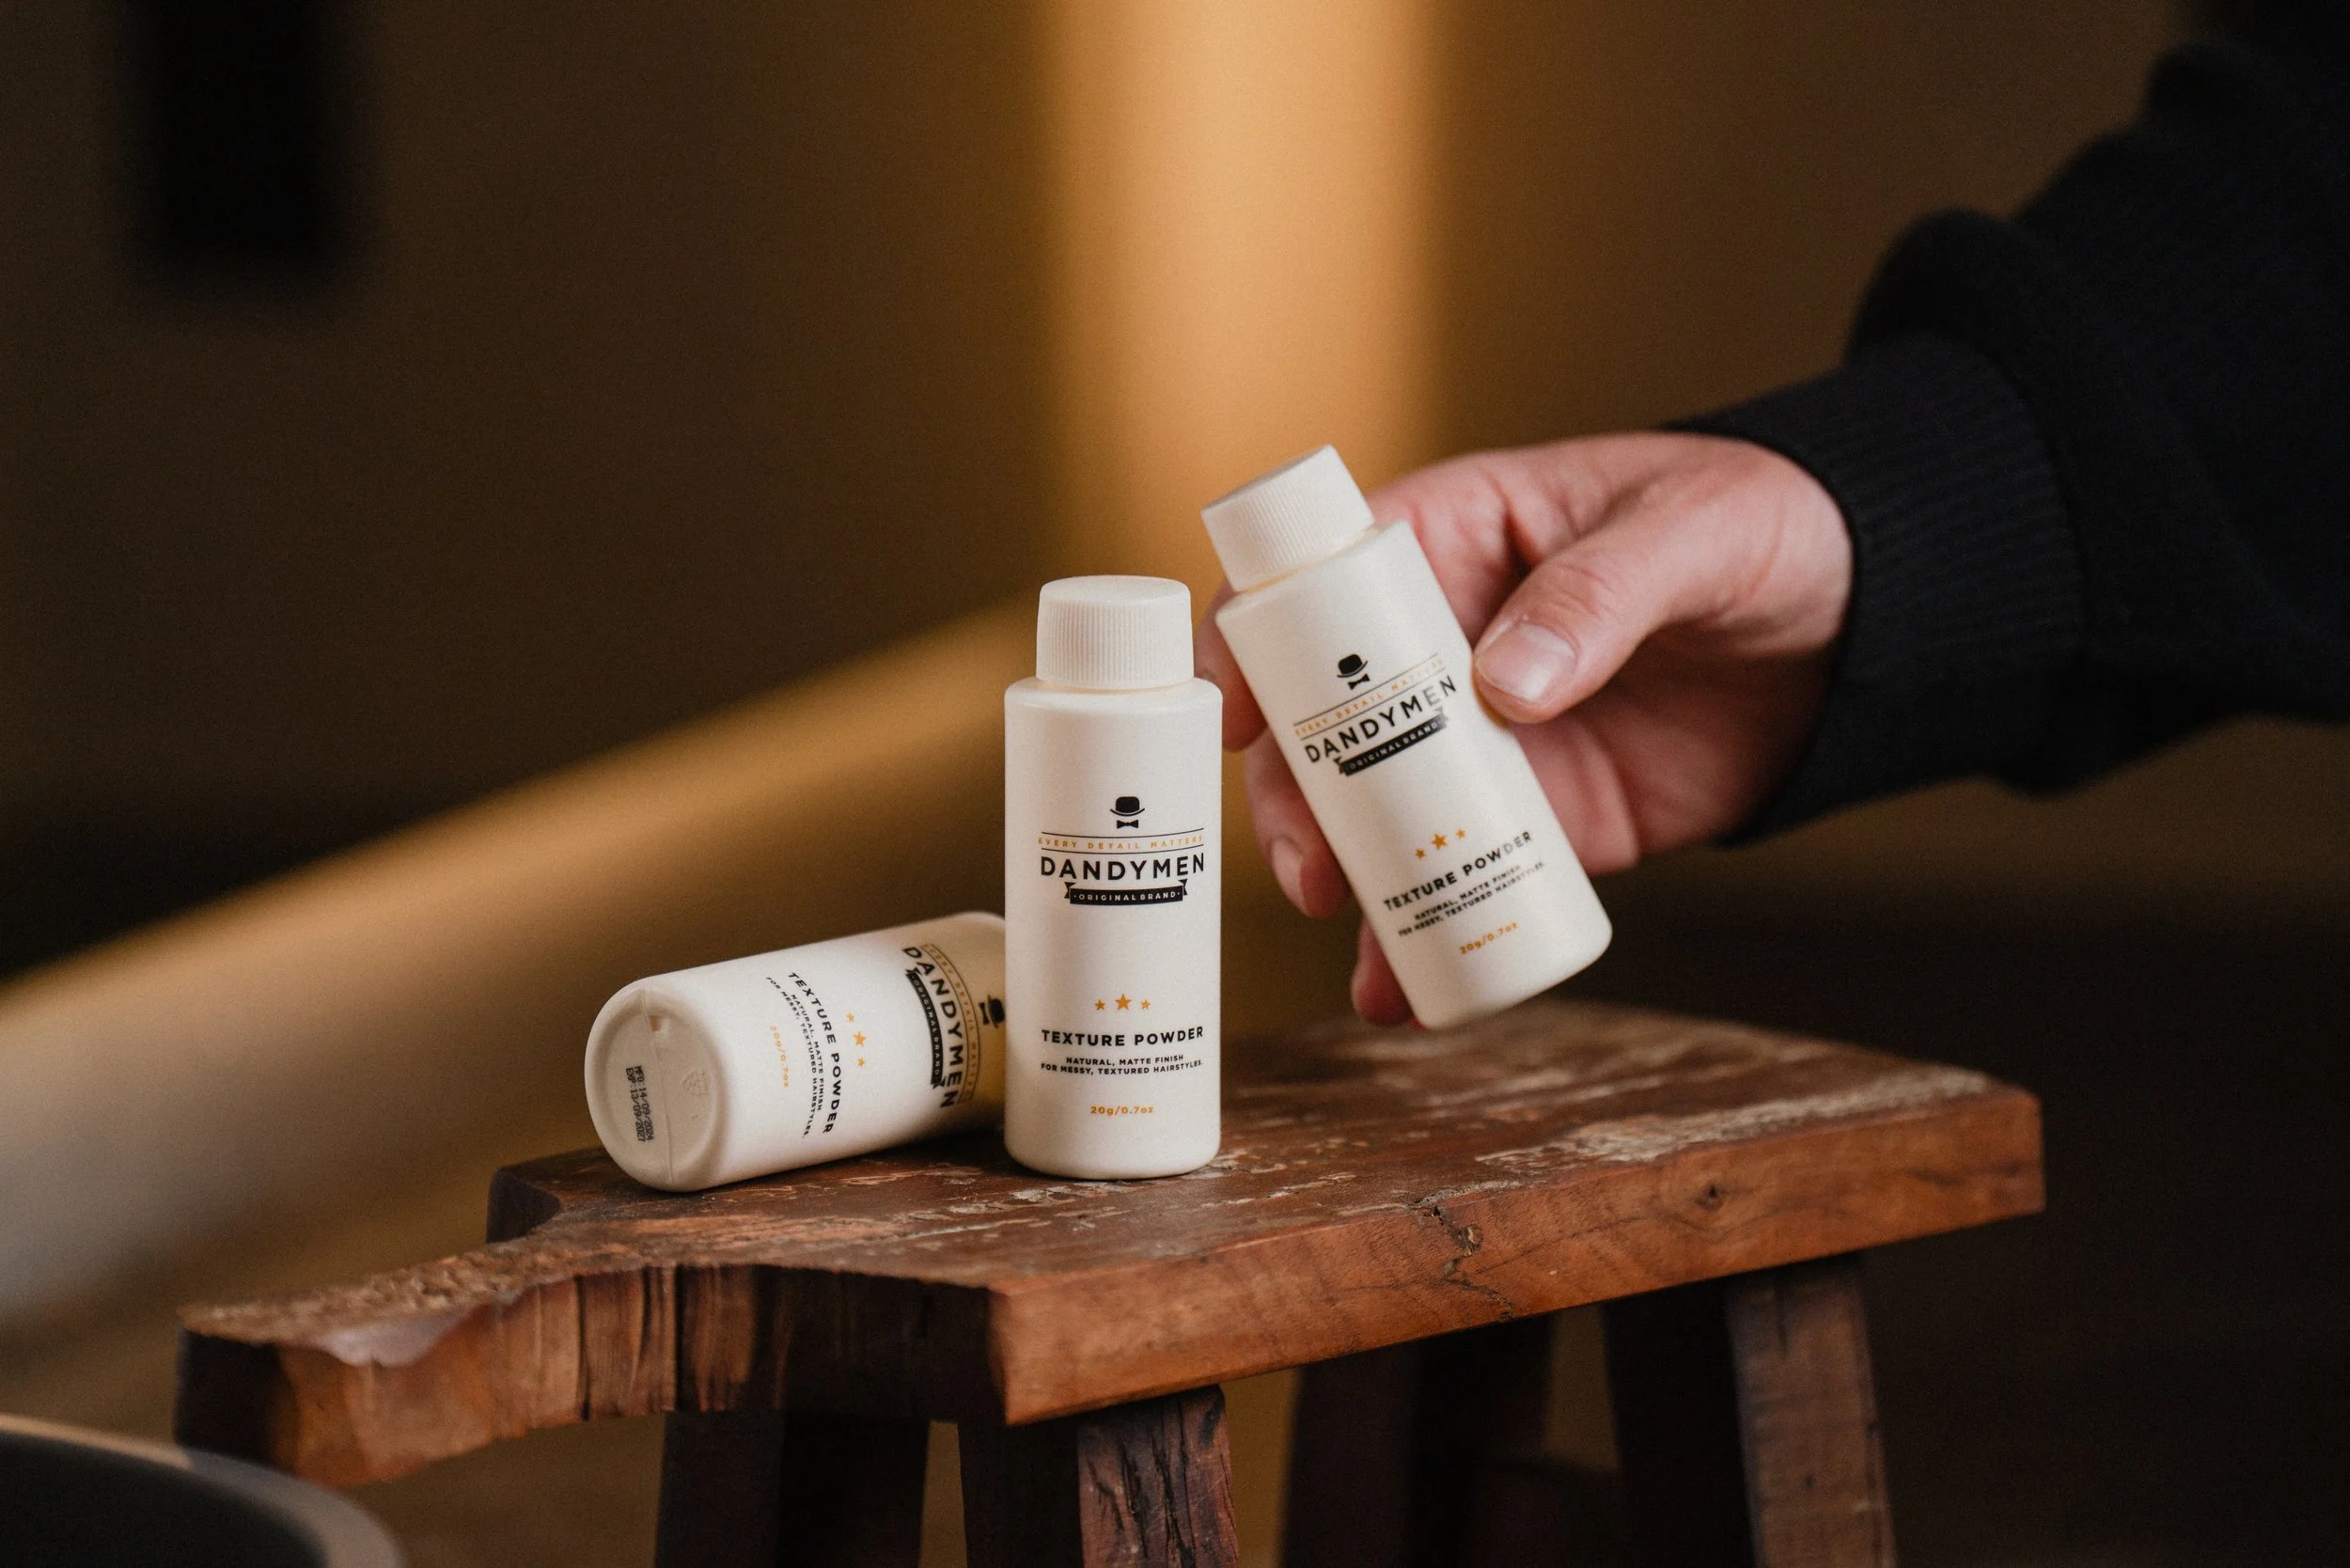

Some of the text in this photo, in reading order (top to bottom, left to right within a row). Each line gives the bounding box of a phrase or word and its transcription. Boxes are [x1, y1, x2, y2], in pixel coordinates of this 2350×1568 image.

[1305, 675, 1456, 762] DANDYMEN
[1349, 721, 1439, 771] ORIGINAL BRAND
[1038, 837, 1078, 849] EVERY
[1151, 835, 1203, 849] MATTERS
[1041, 853, 1204, 881] DANDYMEN
[1384, 831, 1532, 912] TEXTURE POWDER
[1078, 891, 1176, 902] ORIGINAL BRAND
[1445, 891, 1494, 917] TEXTURED
[1460, 881, 1490, 902] MATTE
[914, 980, 937, 1032] ORIGINAL
[902, 947, 964, 1107] DANDYMEN
[1042, 1027, 1203, 1046] TEXTURE POWDER
[788, 972, 841, 1134] TEXTURE POWDER
[801, 1023, 817, 1074] TEXTURED
[814, 1041, 823, 1074] MATTE
[1066, 1057, 1115, 1066] NATURAL,
[1155, 1055, 1183, 1064] FINISH
[1041, 1063, 1058, 1072] FOR
[1060, 1066, 1094, 1075] MESSY,
[1090, 1105, 1154, 1116] 20g/0.7oz
